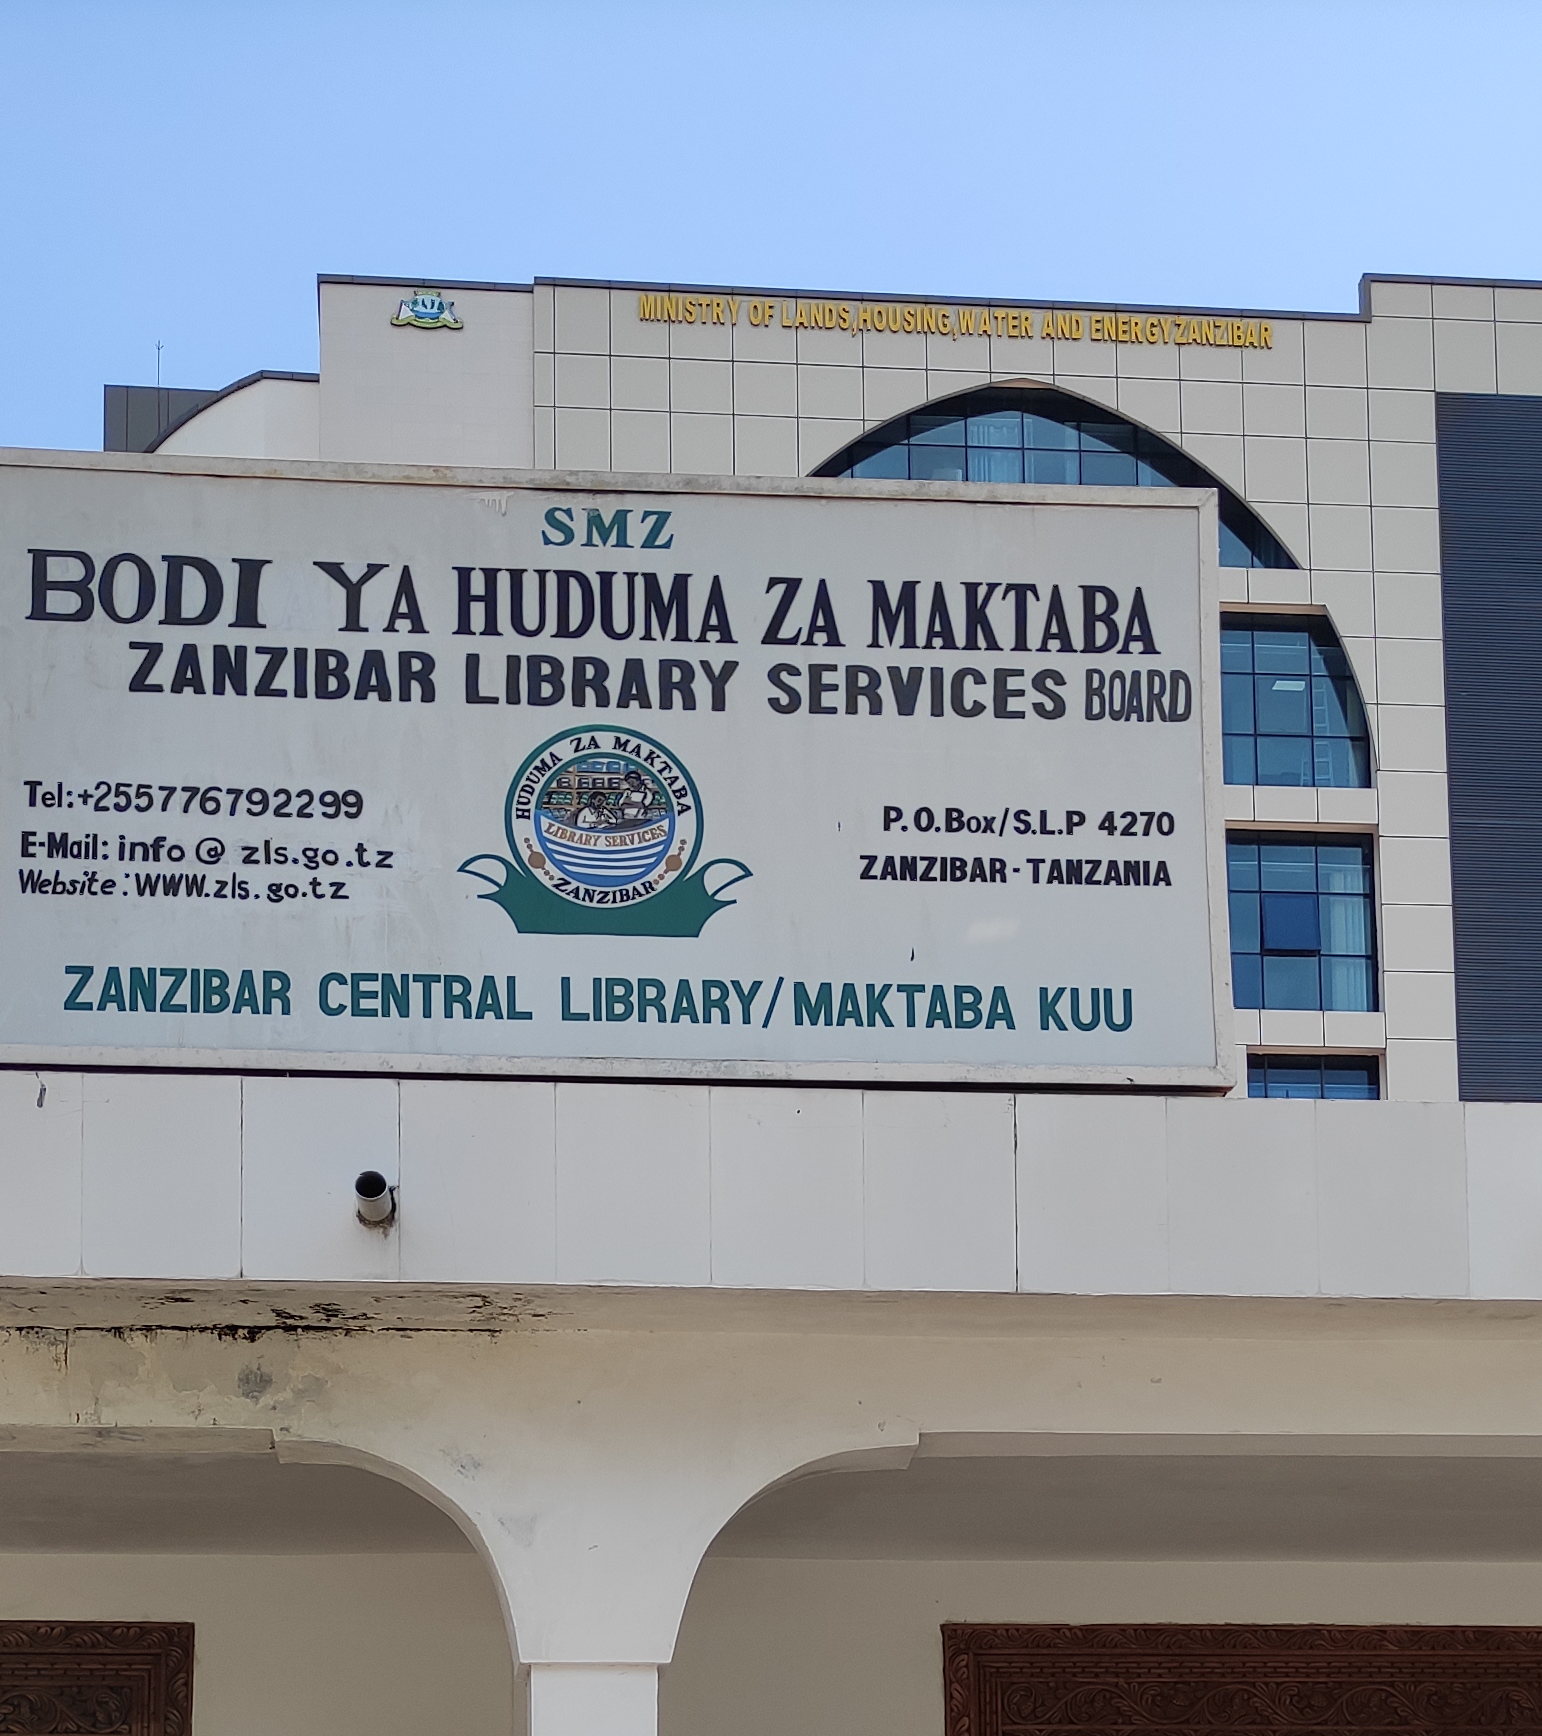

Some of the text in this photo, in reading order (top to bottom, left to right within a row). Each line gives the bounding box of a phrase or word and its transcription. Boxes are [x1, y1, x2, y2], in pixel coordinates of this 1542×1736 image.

[639, 293, 741, 324] MINISTRY
[748, 299, 776, 327] OF
[1042, 313, 1085, 341] AND
[1090, 315, 1173, 344] ENERGY
[1174, 316, 1273, 348] ZANZIBAR
[541, 506, 675, 550] SMZ
[24, 548, 1162, 655] BODI YA HUDUMA ZA MAKTABA
[128, 640, 1192, 723] ZANZIBAR LIBRARY SERVICES BOARD
[513, 733, 694, 823] HUDUMA ZA MAKTABA
[543, 821, 669, 849] LIBRARY SERVICES
[1097, 810, 1175, 837] 4270
[20, 830, 110, 861] E-Mail:
[118, 834, 186, 863] info
[195, 837, 226, 866] @
[551, 877, 658, 906] ZANZIBAR
[859, 854, 1007, 884] ZANZIBAR
[1026, 858, 1173, 887] TANZANIA
[63, 965, 292, 1016] ZANZIBAR
[318, 971, 533, 1021] CENTRAL
[1039, 986, 1133, 1033] KUU
